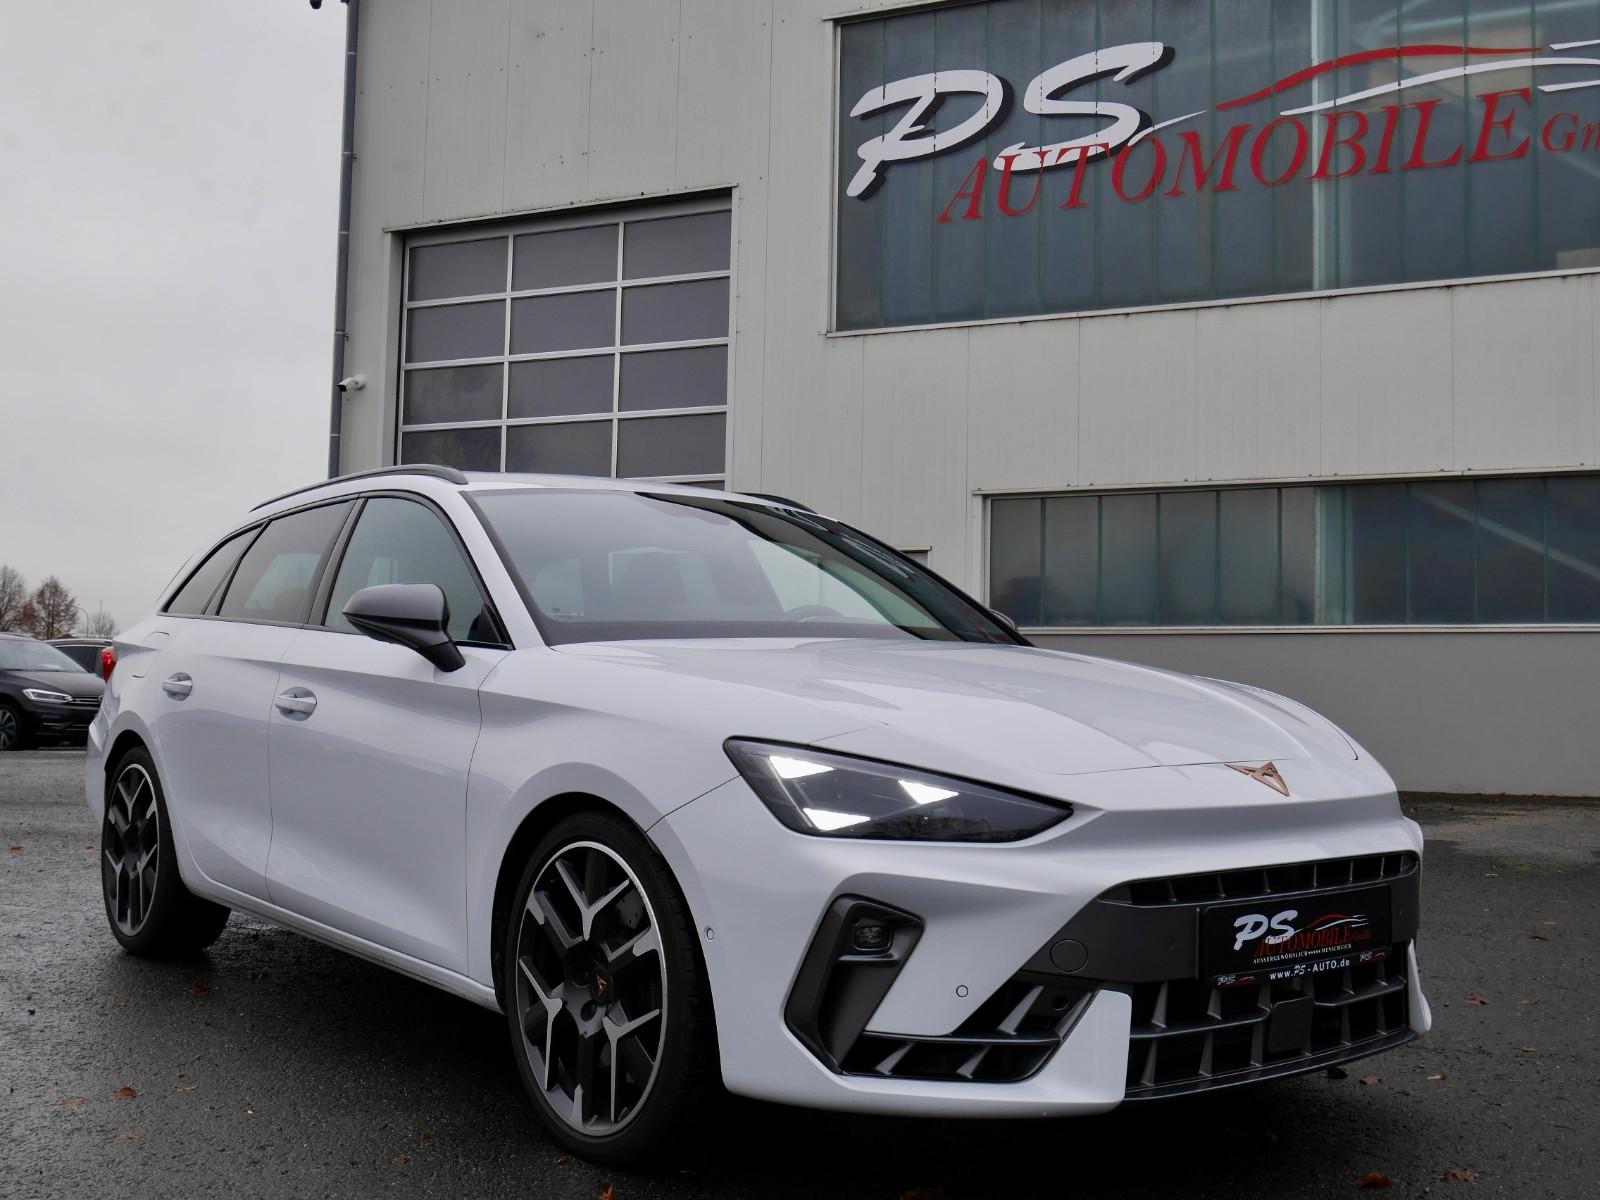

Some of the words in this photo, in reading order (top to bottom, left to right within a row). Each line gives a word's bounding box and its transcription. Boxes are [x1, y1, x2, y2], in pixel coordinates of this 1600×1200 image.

[848, 41, 1172, 199] PS
[937, 88, 1532, 223] AUTOMOBILE
[1233, 909, 1299, 951] PS
[1253, 926, 1351, 957] AUTOMOBILE
